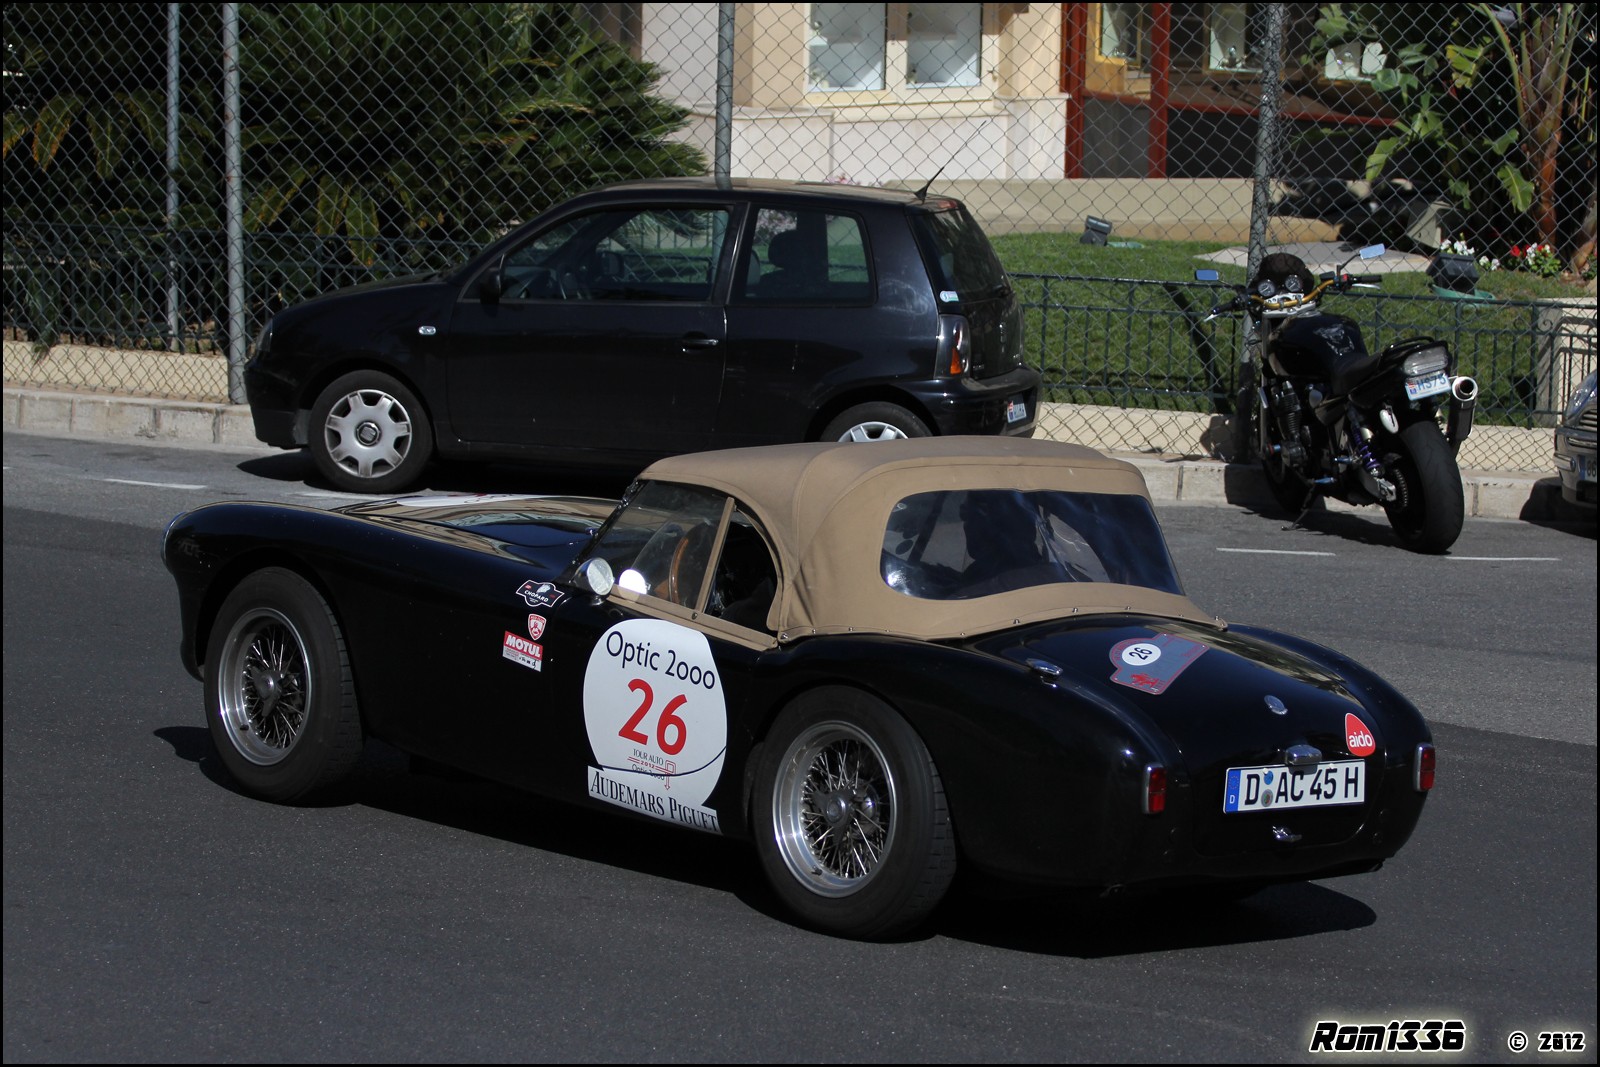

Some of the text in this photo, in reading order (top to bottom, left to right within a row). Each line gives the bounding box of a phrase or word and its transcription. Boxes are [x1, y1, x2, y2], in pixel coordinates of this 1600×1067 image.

[524, 590, 549, 602] CHOPARD
[505, 634, 541, 657] MOTUL
[1129, 647, 1152, 660] 26
[606, 631, 715, 690] Optic 2000
[618, 678, 687, 755] 26
[1349, 731, 1373, 748] aido
[633, 748, 664, 766] TOUR AUTO
[1244, 766, 1359, 806] D AC 45 H
[590, 770, 719, 832] AUDEMARS PIGUET
[1229, 794, 1236, 804] D
